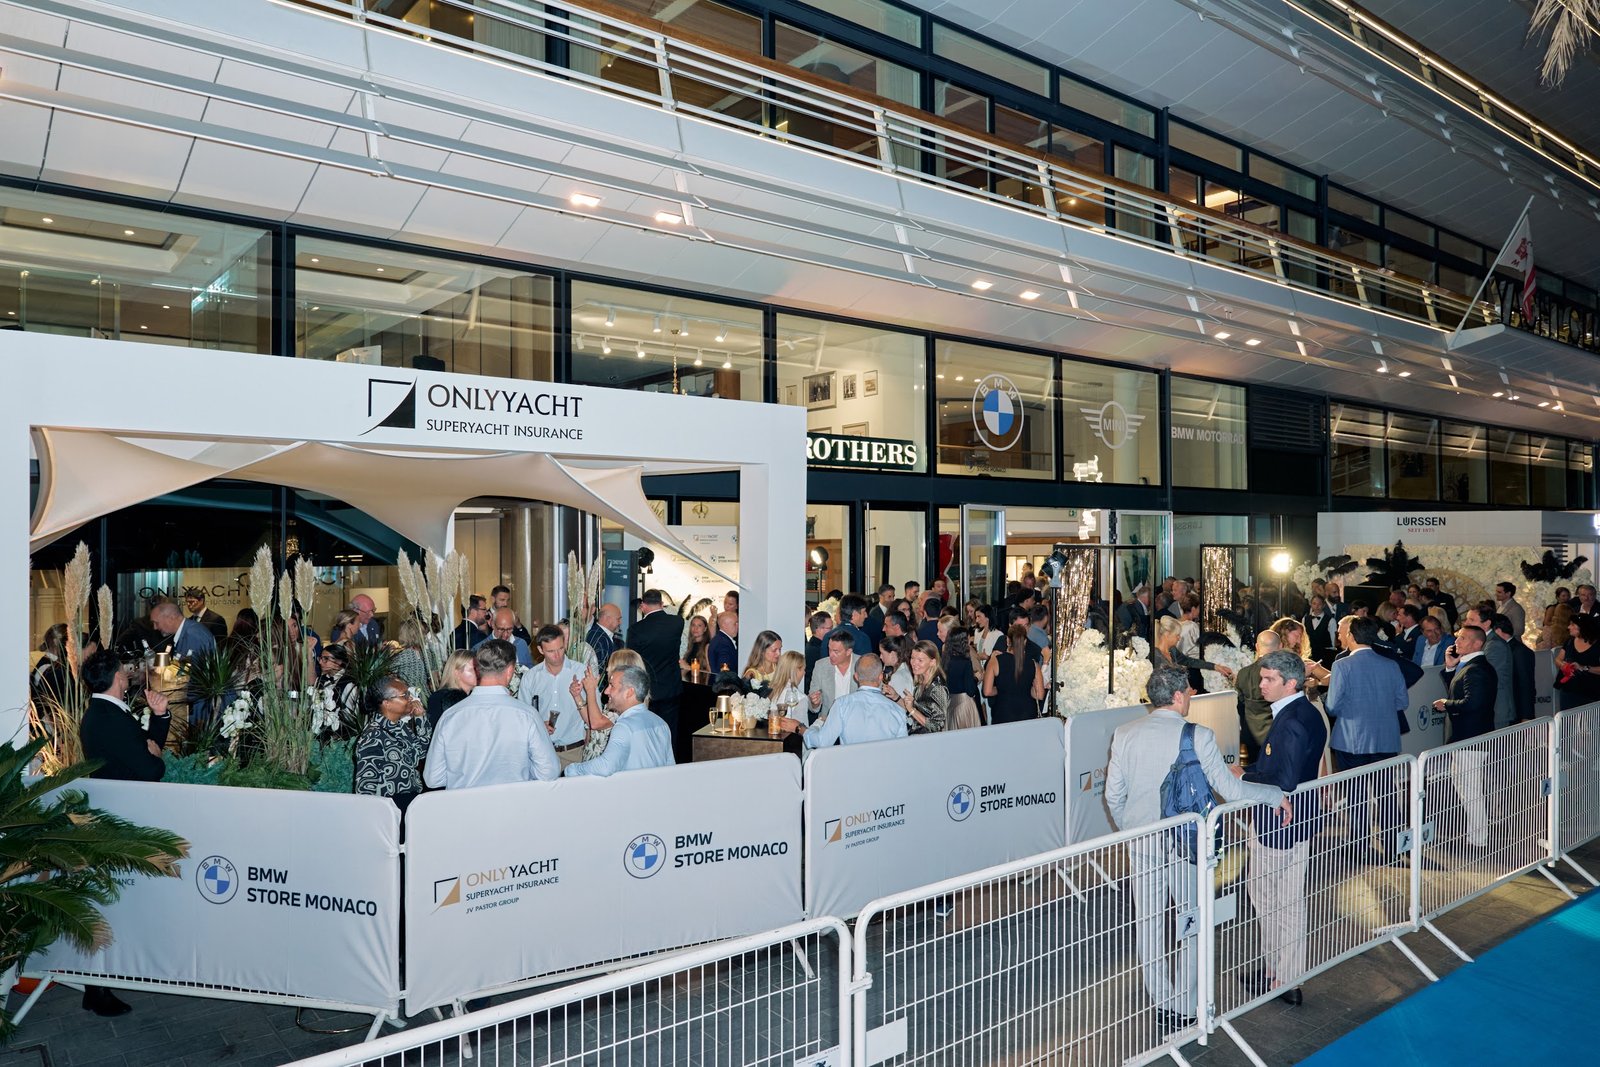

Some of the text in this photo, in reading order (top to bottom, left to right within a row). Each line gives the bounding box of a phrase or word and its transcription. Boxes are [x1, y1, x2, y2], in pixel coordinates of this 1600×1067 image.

[427, 384, 583, 417] ONLYYACHT
[426, 419, 583, 440] SUPERYACHT INSURANCE
[1103, 419, 1124, 432] MINI
[1171, 426, 1245, 445] BMW MOTORRAD
[980, 783, 1006, 797] BMW
[980, 792, 1056, 813] STORE MONACO
[845, 804, 905, 827] ONLYYACHT
[844, 819, 905, 839] SUPERYACHT INSURANCE
[674, 832, 713, 849] BMW
[674, 842, 788, 868] STORE MONACO
[247, 866, 288, 884] BMW
[466, 858, 559, 887] ONLYYACHT
[465, 876, 559, 902] SUPERYACHT INSURANCE
[247, 887, 377, 916] STORE MONACO
[475, 901, 497, 912] PASTOR
[498, 897, 520, 907] GROUP
